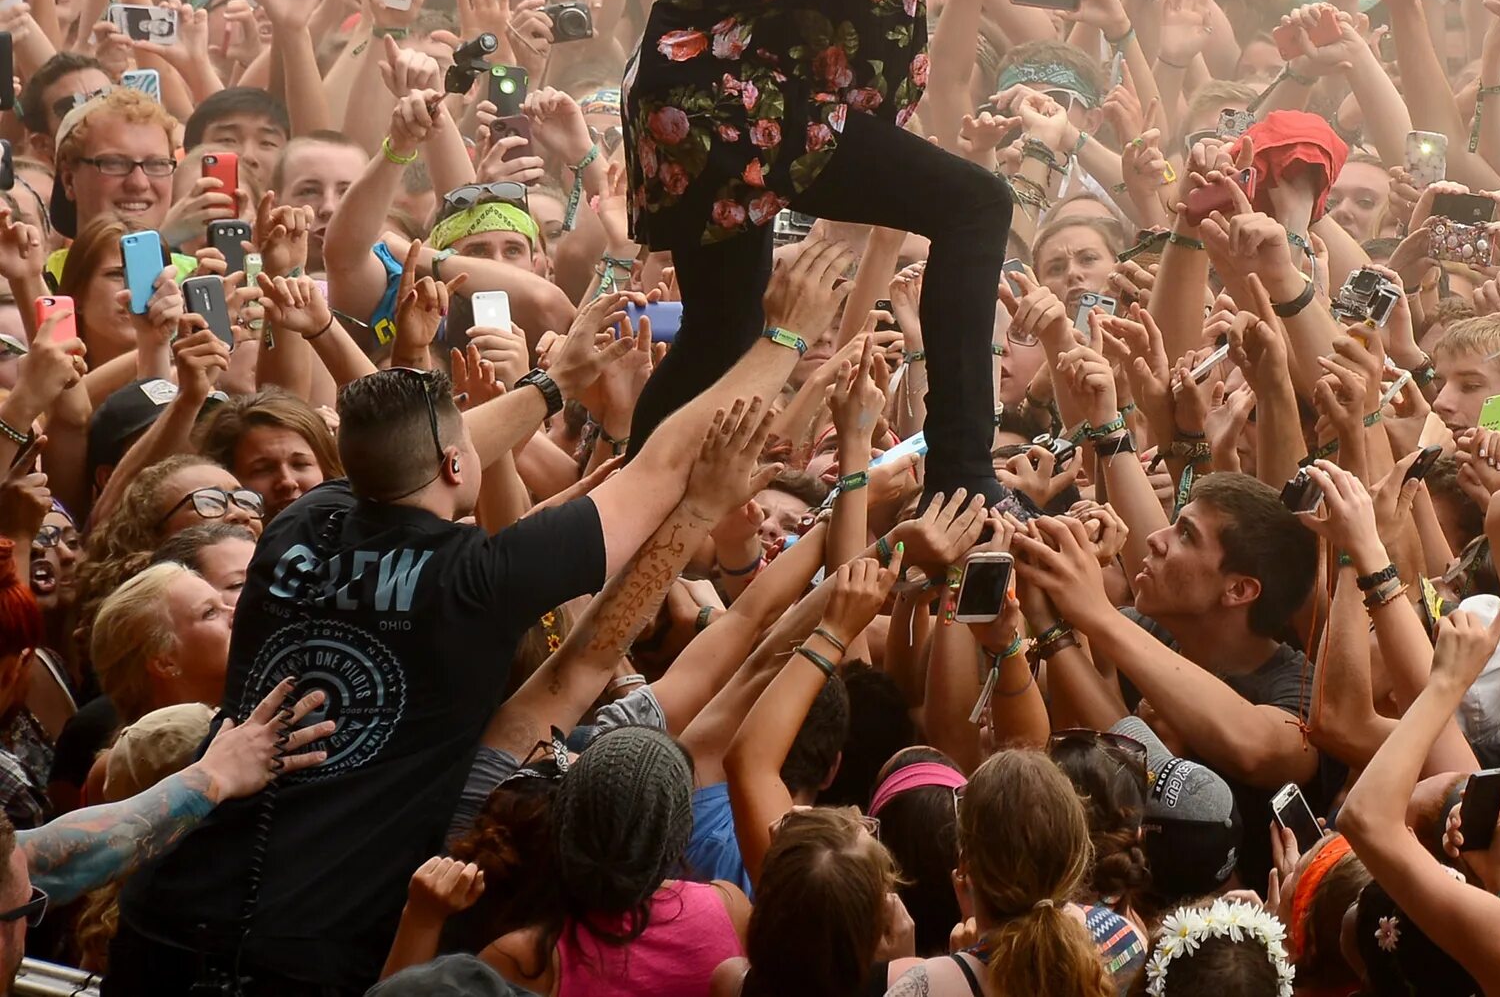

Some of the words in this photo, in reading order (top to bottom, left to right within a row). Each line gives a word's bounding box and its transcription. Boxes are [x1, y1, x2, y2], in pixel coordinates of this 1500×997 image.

[268, 543, 434, 612] CREW
[379, 620, 412, 632] OHIO
[316, 651, 341, 669] ONE
[341, 659, 371, 700] PILOTS
[340, 707, 362, 715] GOOD
[1165, 777, 1184, 809] CUP
